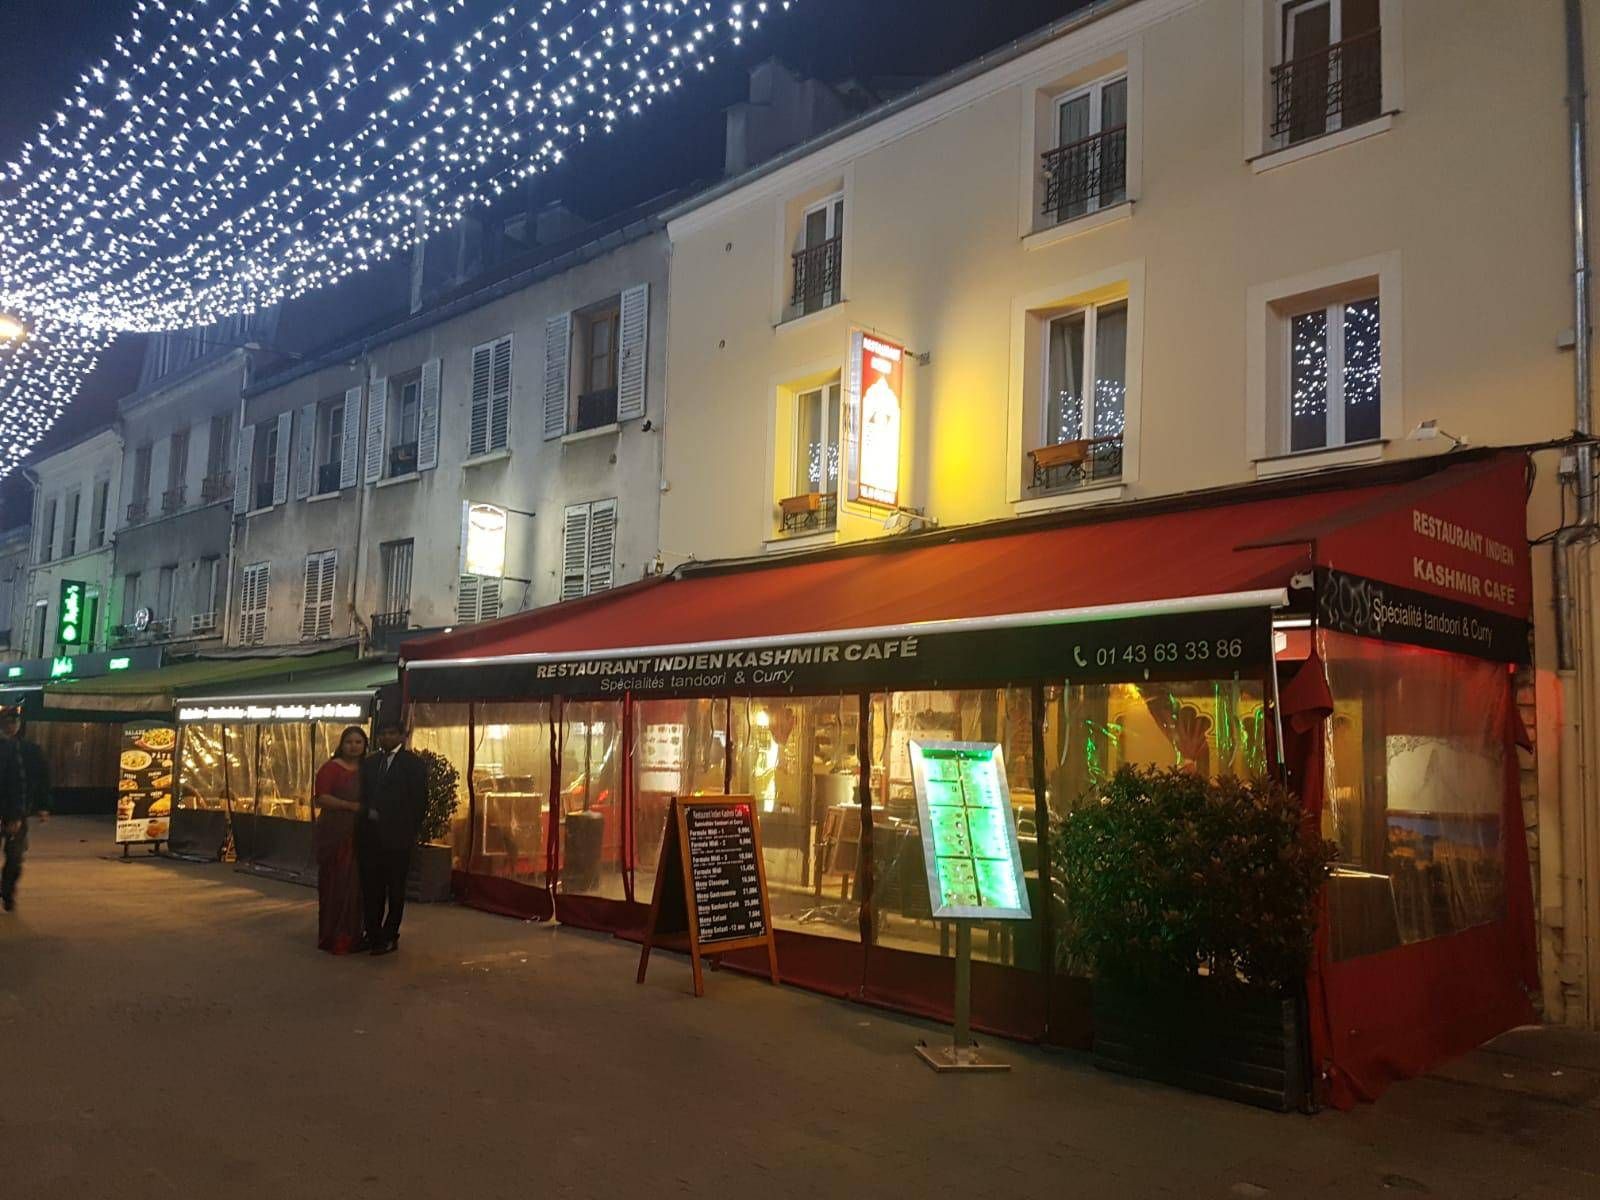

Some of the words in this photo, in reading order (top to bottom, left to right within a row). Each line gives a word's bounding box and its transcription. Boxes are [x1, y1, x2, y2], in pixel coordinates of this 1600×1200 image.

[1413, 510, 1484, 555] RESTAURANT
[1485, 537, 1514, 566] INDIEN
[1413, 557, 1481, 597] KASHMIR
[1484, 578, 1515, 605] CAFÉ
[1424, 614, 1461, 636] tandoori
[1463, 618, 1469, 637] &
[1471, 619, 1493, 648] Curry
[536, 658, 653, 679] RESTAURANT
[653, 654, 726, 673] INDIEN
[727, 645, 839, 669] KASHMIR
[844, 636, 918, 661] CAFÉ
[1096, 647, 1116, 666] 01
[1122, 644, 1147, 663] 43
[1154, 642, 1178, 662] 63
[1185, 640, 1209, 660] 33
[1216, 638, 1242, 658] 86
[600, 676, 665, 692] Spécialités
[671, 672, 727, 688] tandoori
[734, 670, 746, 685] &
[752, 668, 794, 687] Curry
